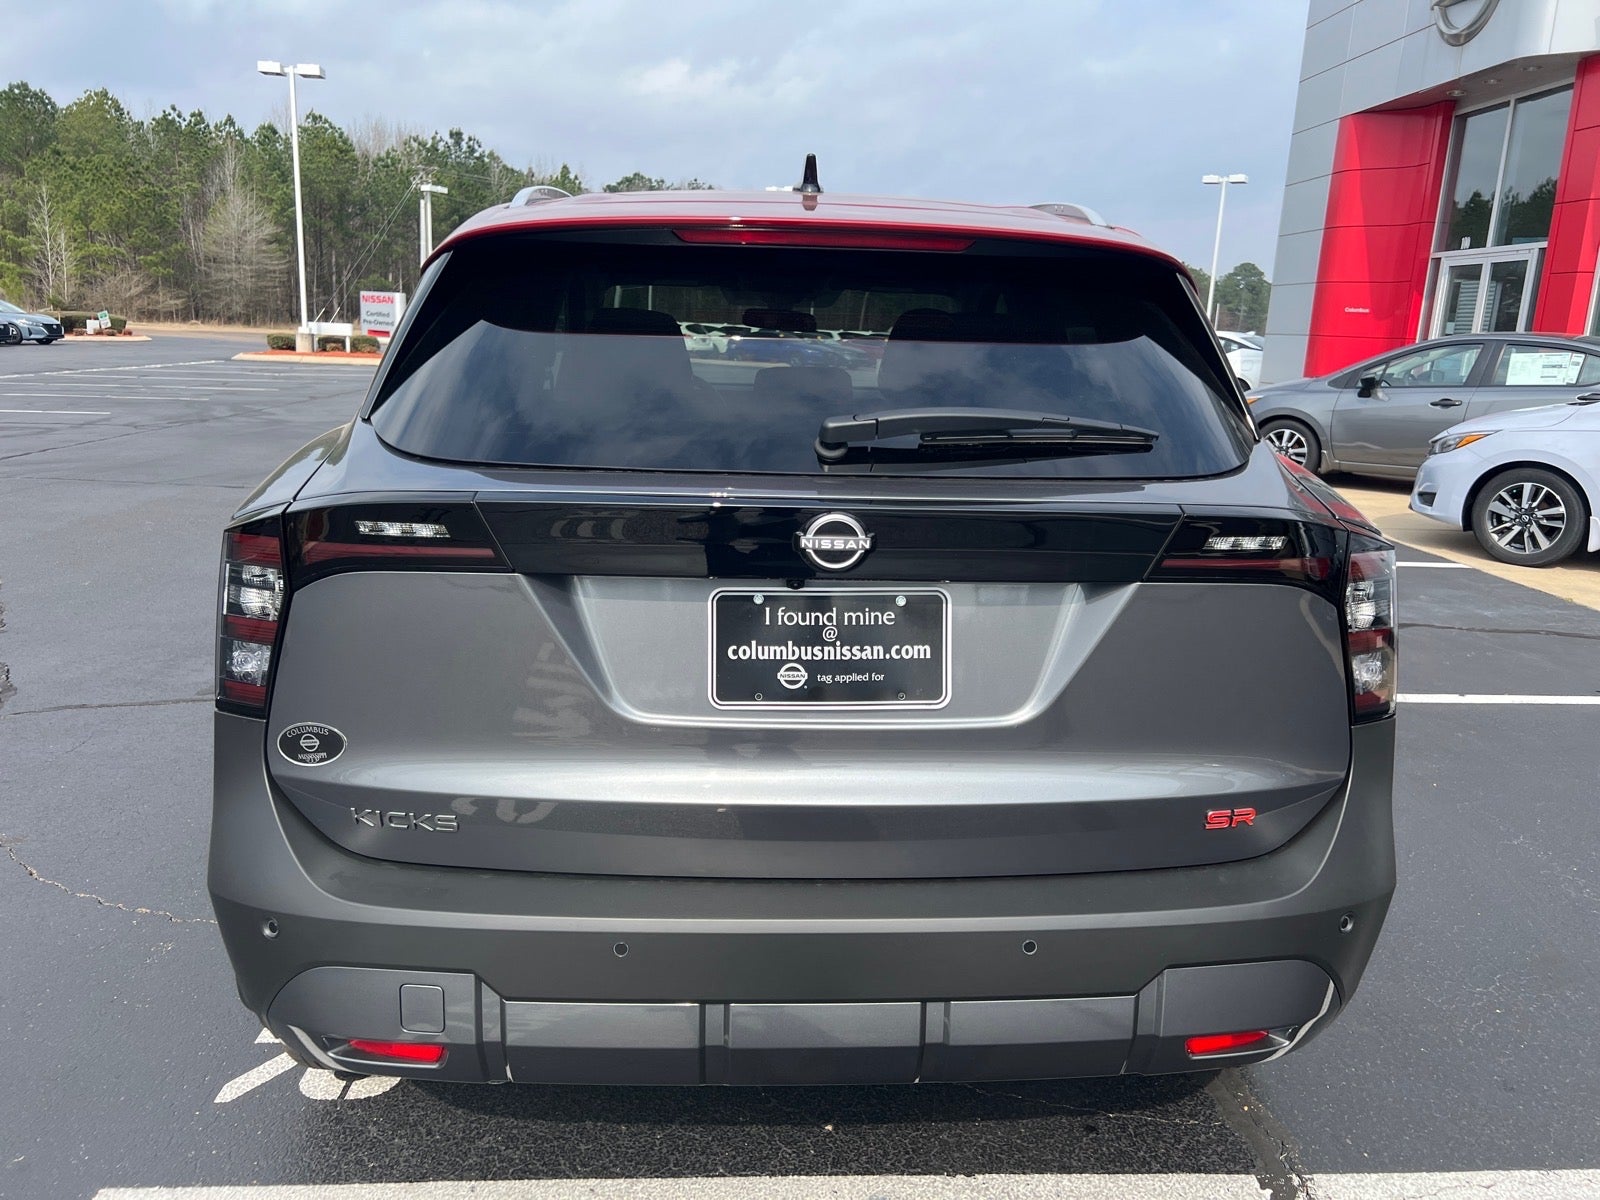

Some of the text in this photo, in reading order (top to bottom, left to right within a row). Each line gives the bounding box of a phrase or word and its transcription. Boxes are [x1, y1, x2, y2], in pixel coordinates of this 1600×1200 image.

[362, 295, 394, 304] NISSAN
[801, 538, 870, 549] NISSAN
[764, 606, 896, 626] I found mine
[822, 626, 839, 642] @
[727, 640, 931, 661] columbusnissan.com
[817, 672, 885, 684] tag applied for
[286, 725, 329, 738] COLUMBUS
[350, 807, 460, 833] KICKS
[1204, 807, 1256, 829] SR
